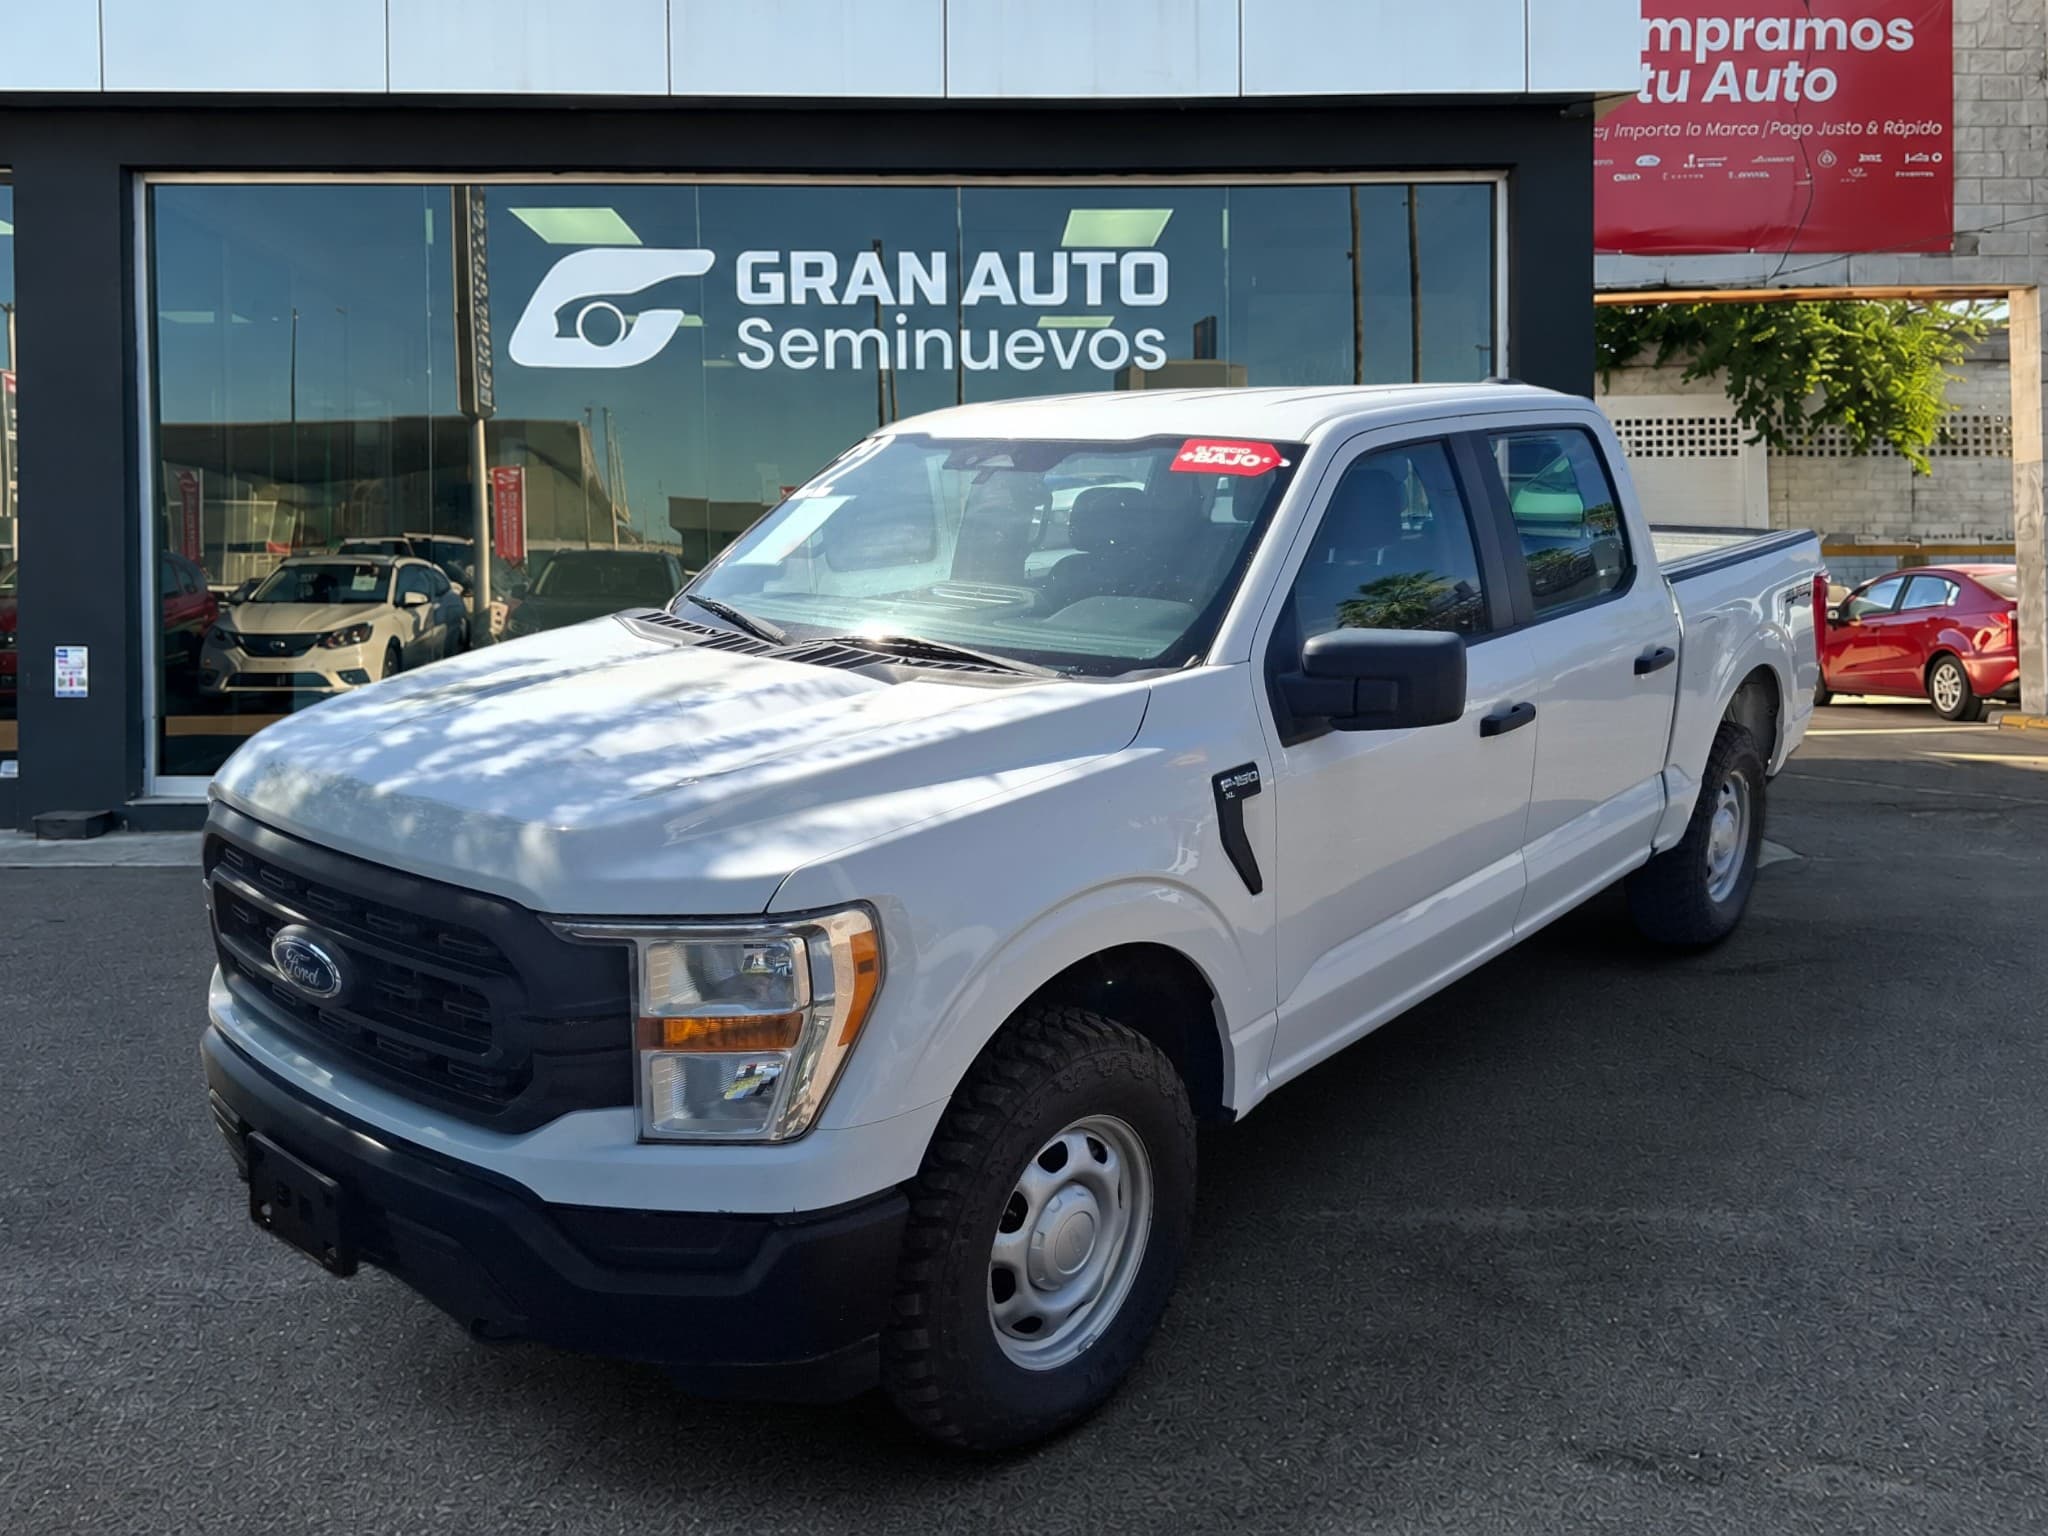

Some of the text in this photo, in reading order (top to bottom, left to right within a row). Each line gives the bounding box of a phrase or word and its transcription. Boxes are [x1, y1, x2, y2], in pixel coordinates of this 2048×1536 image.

[1637, 61, 1838, 103] tu Auto
[1614, 123, 1681, 141] Importa
[1706, 122, 1759, 136] Marca
[1817, 122, 1863, 137] Justo
[1866, 121, 1878, 136] &
[1883, 119, 1943, 138] Rápido
[736, 250, 1169, 305] GRAN AUTO
[737, 313, 1168, 371] Seminuevos
[1220, 770, 1259, 792] F-150
[1225, 791, 1236, 800] XL
[283, 949, 321, 986] Ford
